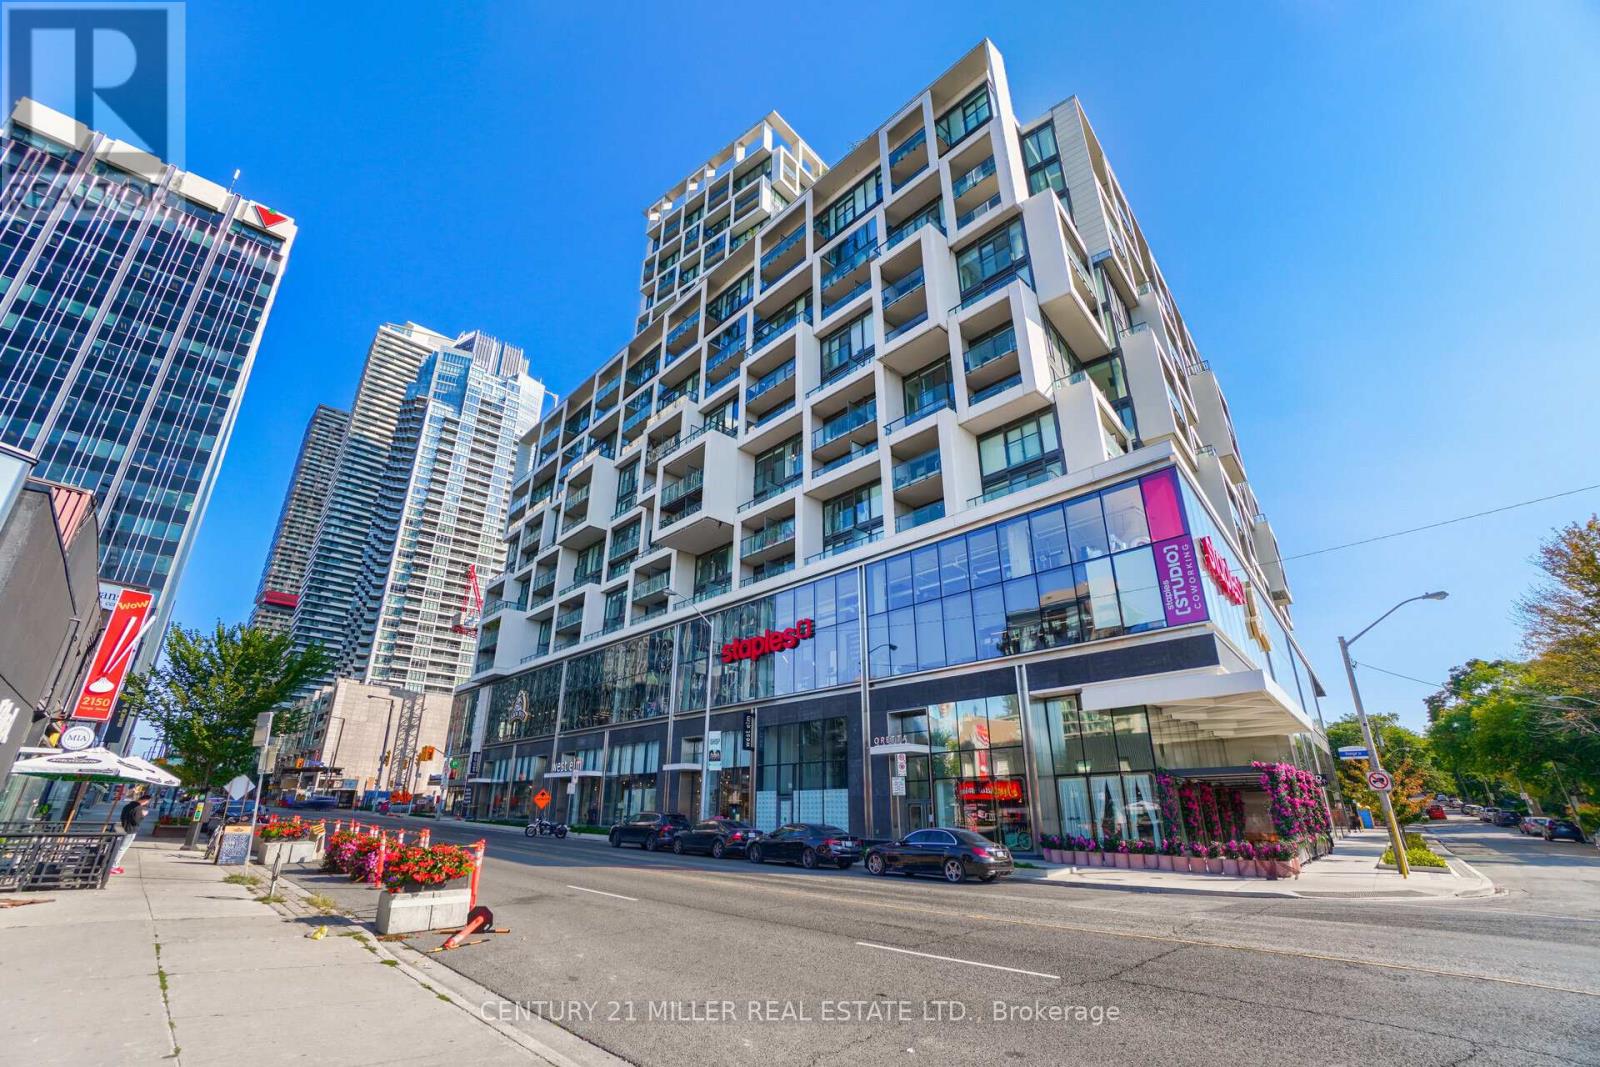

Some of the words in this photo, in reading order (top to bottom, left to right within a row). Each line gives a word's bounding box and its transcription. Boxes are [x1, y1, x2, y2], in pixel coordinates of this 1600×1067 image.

[1182, 544, 1201, 609] COWORKING
[1163, 580, 1174, 610] staples
[721, 628, 799, 663] staples
[81, 696, 111, 707] 2150
